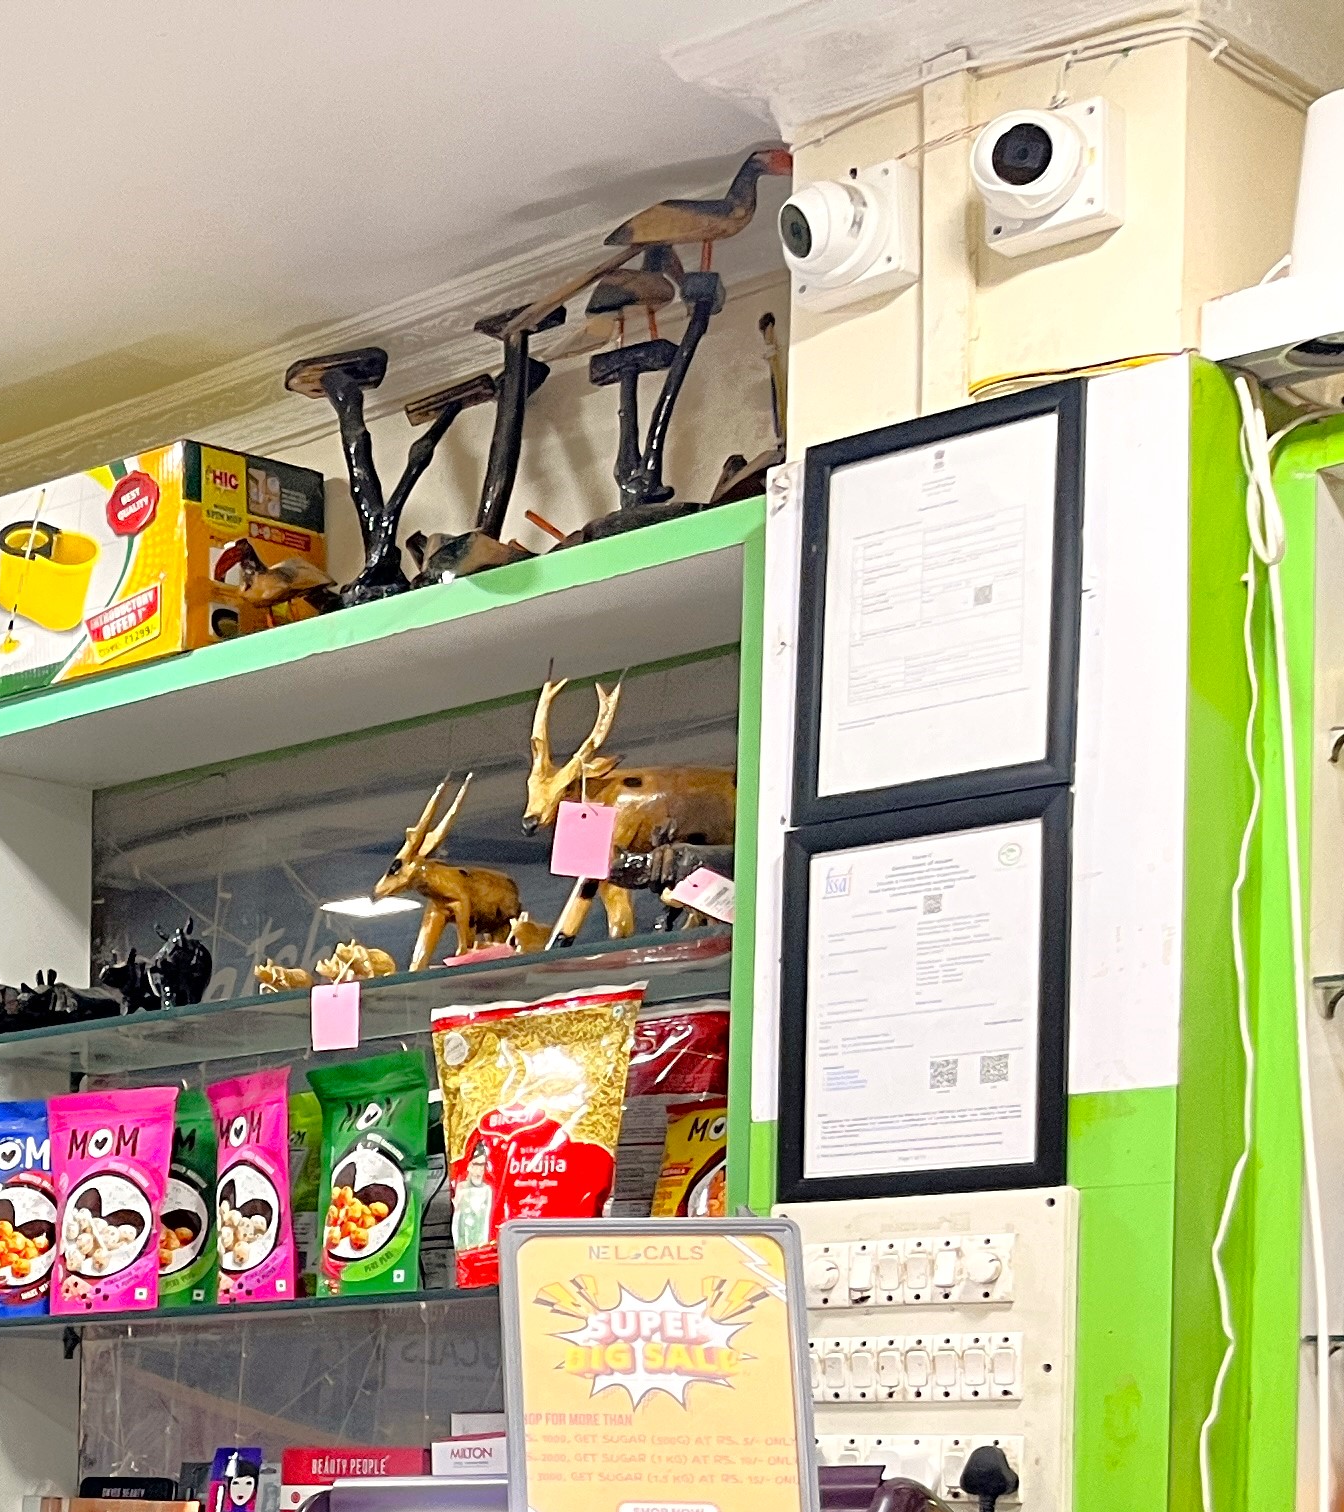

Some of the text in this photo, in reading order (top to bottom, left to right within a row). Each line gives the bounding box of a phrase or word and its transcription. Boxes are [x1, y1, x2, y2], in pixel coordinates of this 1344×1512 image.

[212, 469, 239, 489] HIC
[120, 487, 141, 505] BEST
[117, 497, 149, 521] QUALITY
[509, 1154, 567, 1177] bhujia
[587, 1311, 712, 1344] SUPER
[565, 1344, 744, 1379] BIG SALE
[545, 1413, 633, 1427] FOR MORE THAN
[574, 1434, 597, 1445] GET
[601, 1434, 647, 1445] SUGAR
[694, 1436, 712, 1447] AT
[449, 1446, 494, 1461] MILTON
[574, 1453, 598, 1464] GET
[601, 1453, 647, 1464] SUGAR
[691, 1454, 710, 1465] AT
[311, 1457, 387, 1476] BEAUTY PEOPLE
[570, 1471, 595, 1482] GET
[598, 1471, 643, 1483] SUGAR
[698, 1473, 716, 1484] AT
